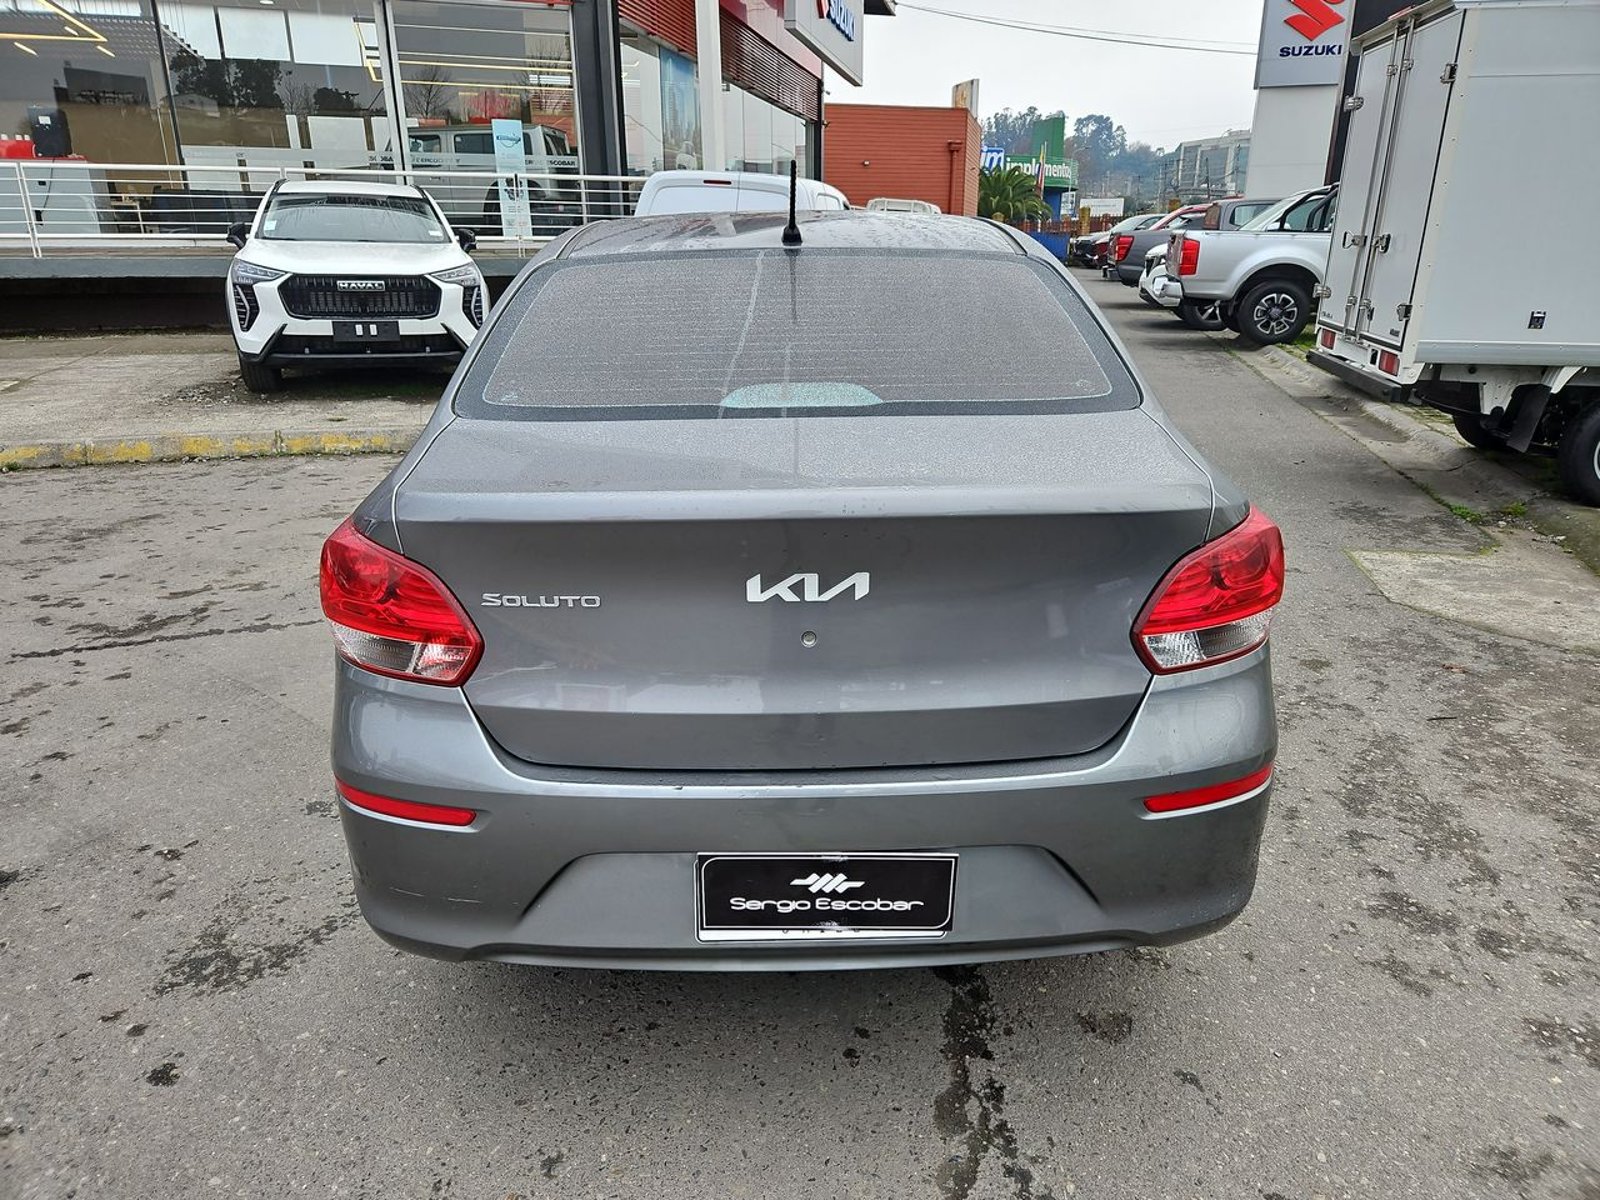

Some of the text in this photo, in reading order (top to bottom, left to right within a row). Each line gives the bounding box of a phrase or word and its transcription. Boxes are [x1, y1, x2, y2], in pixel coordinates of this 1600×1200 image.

[1279, 44, 1343, 57] SUZUKI
[746, 571, 870, 603] KIA
[480, 592, 602, 608] SOLUTO
[729, 897, 925, 914] Sergio Escobar
